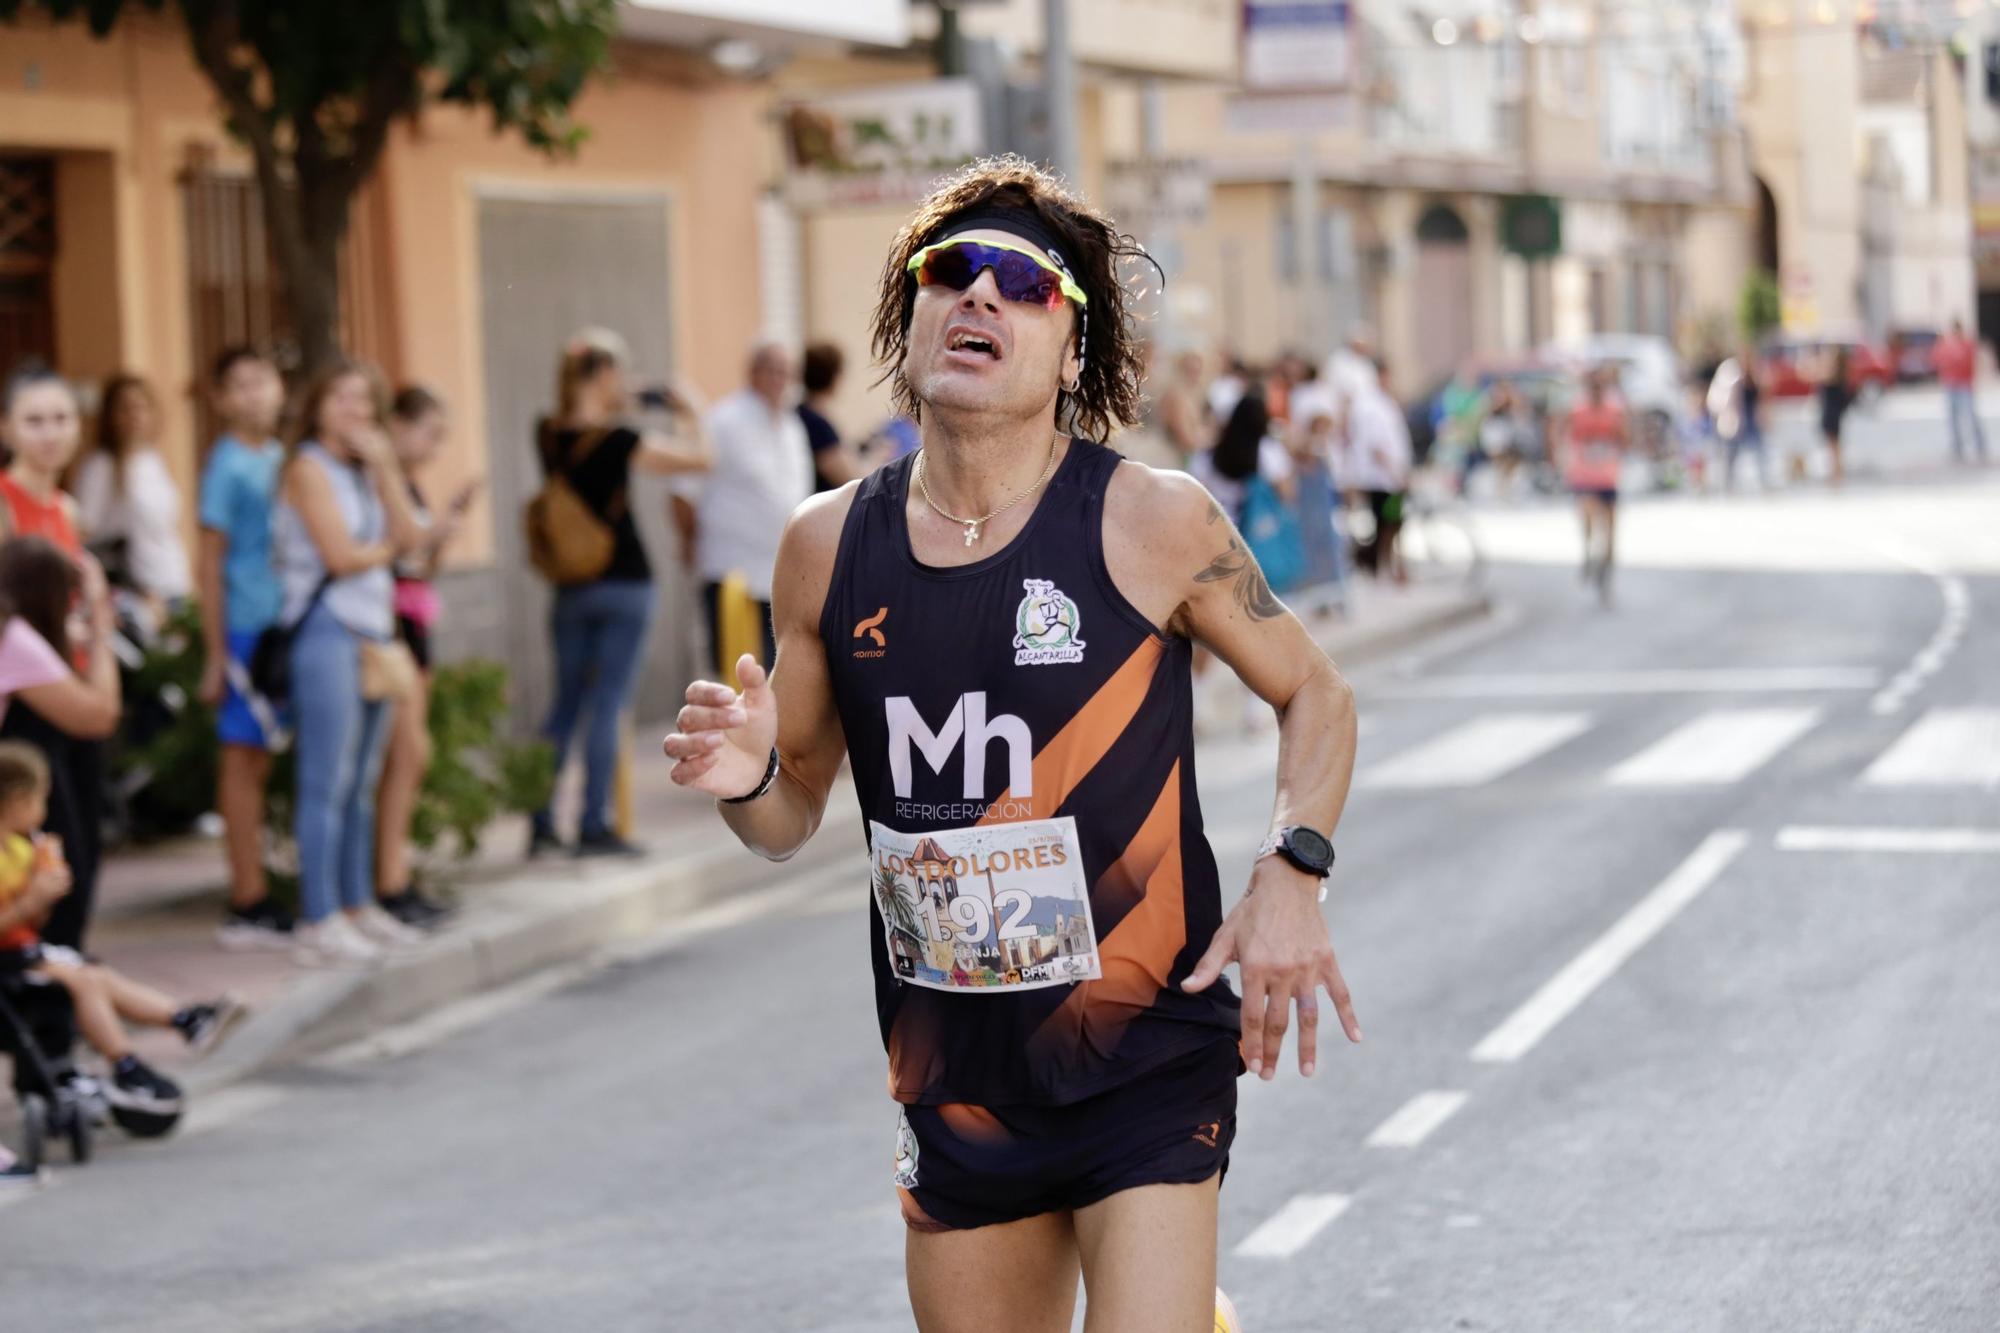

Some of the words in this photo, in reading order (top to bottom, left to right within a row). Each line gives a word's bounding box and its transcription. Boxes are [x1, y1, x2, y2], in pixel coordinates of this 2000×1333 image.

[1018, 650, 1079, 662] ALCANTARILLA
[885, 690, 1033, 799] Mh
[877, 849, 918, 878] LOS
[924, 842, 1068, 881] DOLORES
[915, 888, 1038, 943] 192
